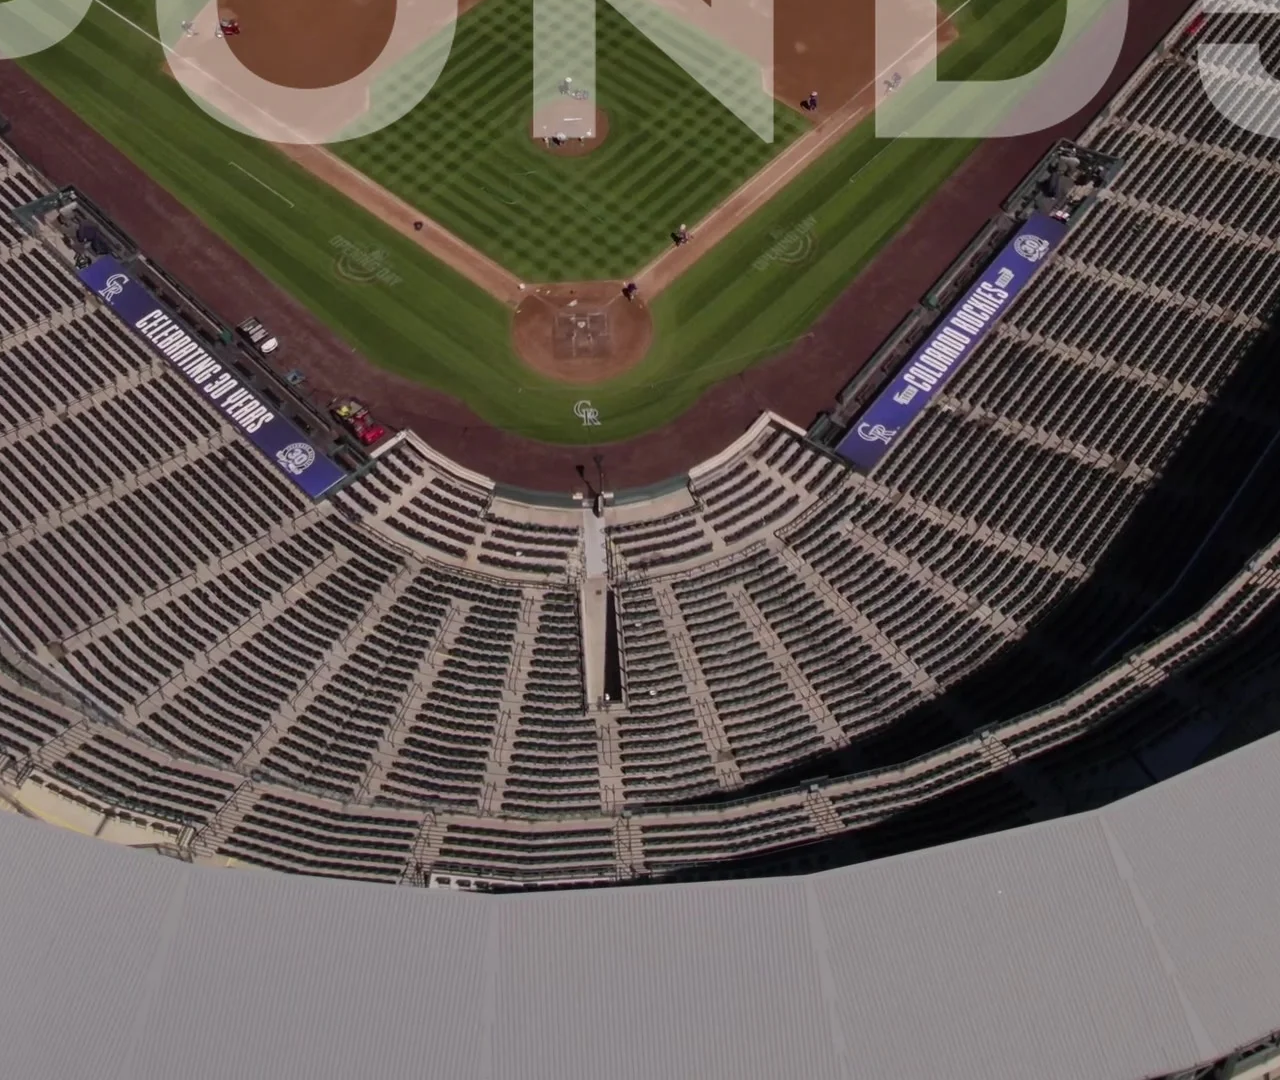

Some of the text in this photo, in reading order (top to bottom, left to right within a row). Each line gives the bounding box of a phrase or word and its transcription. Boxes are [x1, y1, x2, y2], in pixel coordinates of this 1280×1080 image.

[135, 309, 275, 434] CELEBRATING 30 YEARS
[903, 281, 1009, 392] COLORADO ROCKIES
